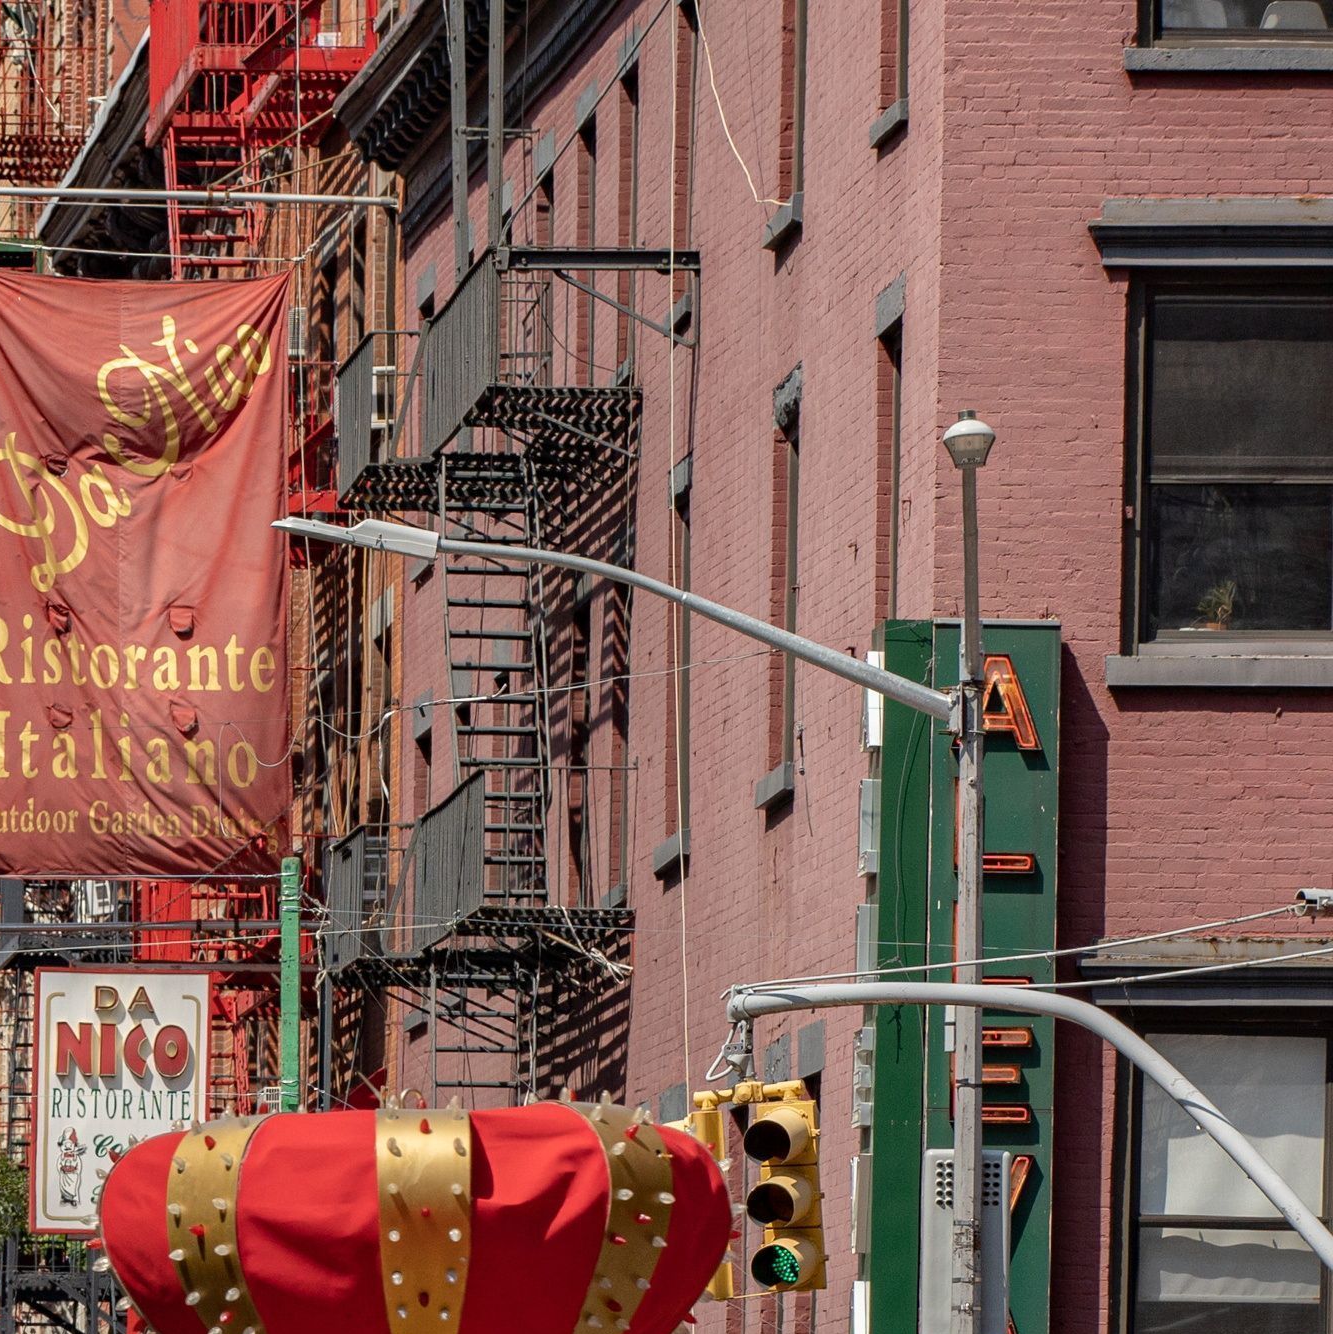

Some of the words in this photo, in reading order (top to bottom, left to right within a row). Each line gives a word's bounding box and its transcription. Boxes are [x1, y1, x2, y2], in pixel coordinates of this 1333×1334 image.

[97, 315, 272, 477] Nico
[89, 800, 181, 837] Garden
[95, 986, 155, 1013] DA
[56, 1022, 189, 1079] NICO
[52, 1088, 191, 1121] RISTORANTE
